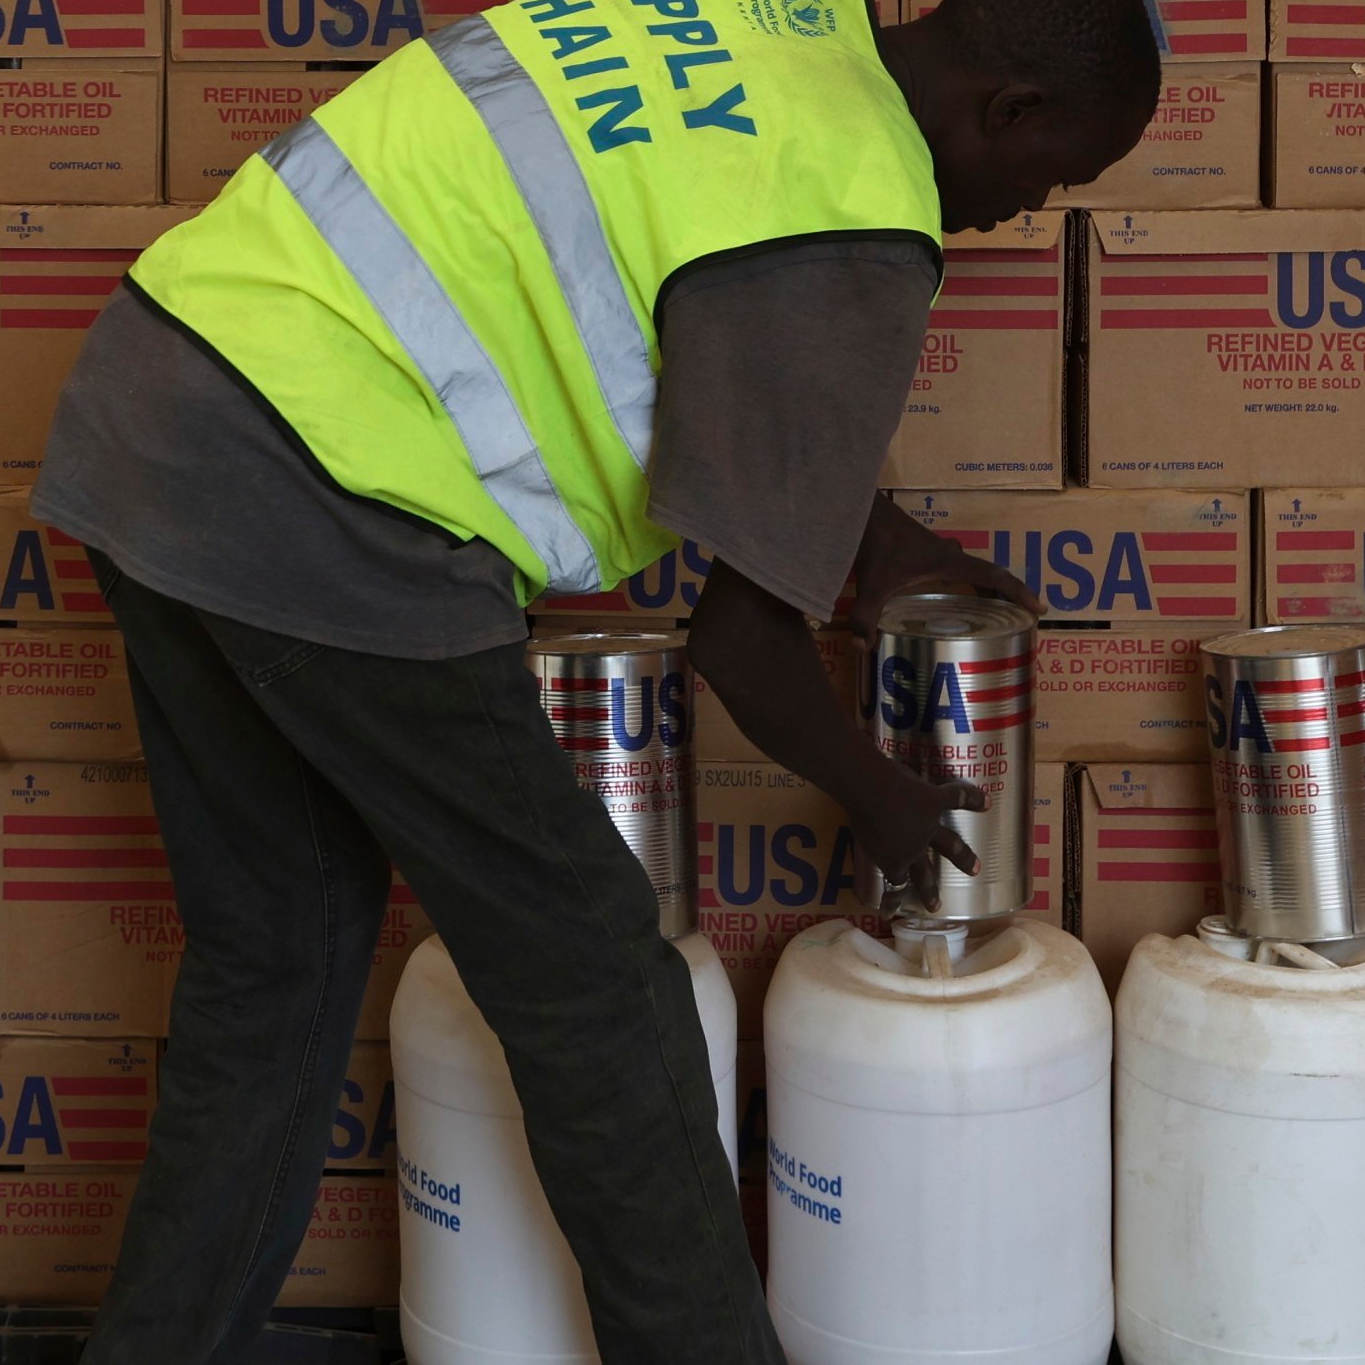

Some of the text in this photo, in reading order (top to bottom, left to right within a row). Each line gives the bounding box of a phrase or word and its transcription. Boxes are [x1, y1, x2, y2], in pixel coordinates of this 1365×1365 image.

[824, 8, 836, 32] WFP
[1244, 403, 1339, 414] NET WEIGHT: 22.0 kg.
[955, 463, 1053, 471] CUBIC METERS: 0.036
[611, 672, 695, 752] US
[1205, 674, 1273, 753] SA
[878, 738, 1007, 759] VEGETABLE OIL
[576, 760, 651, 777] REFINED
[1215, 764, 1317, 779] GETABLE OIL
[651, 778, 662, 794] A
[665, 777, 675, 792] &
[1232, 782, 1320, 798] FORTIFIED
[632, 802, 648, 812] BE
[1241, 803, 1317, 815] EXCHANGED
[769, 1138, 842, 1197] World Food
[398, 1156, 460, 1206] orld Food
[399, 1179, 460, 1232] ogramme
